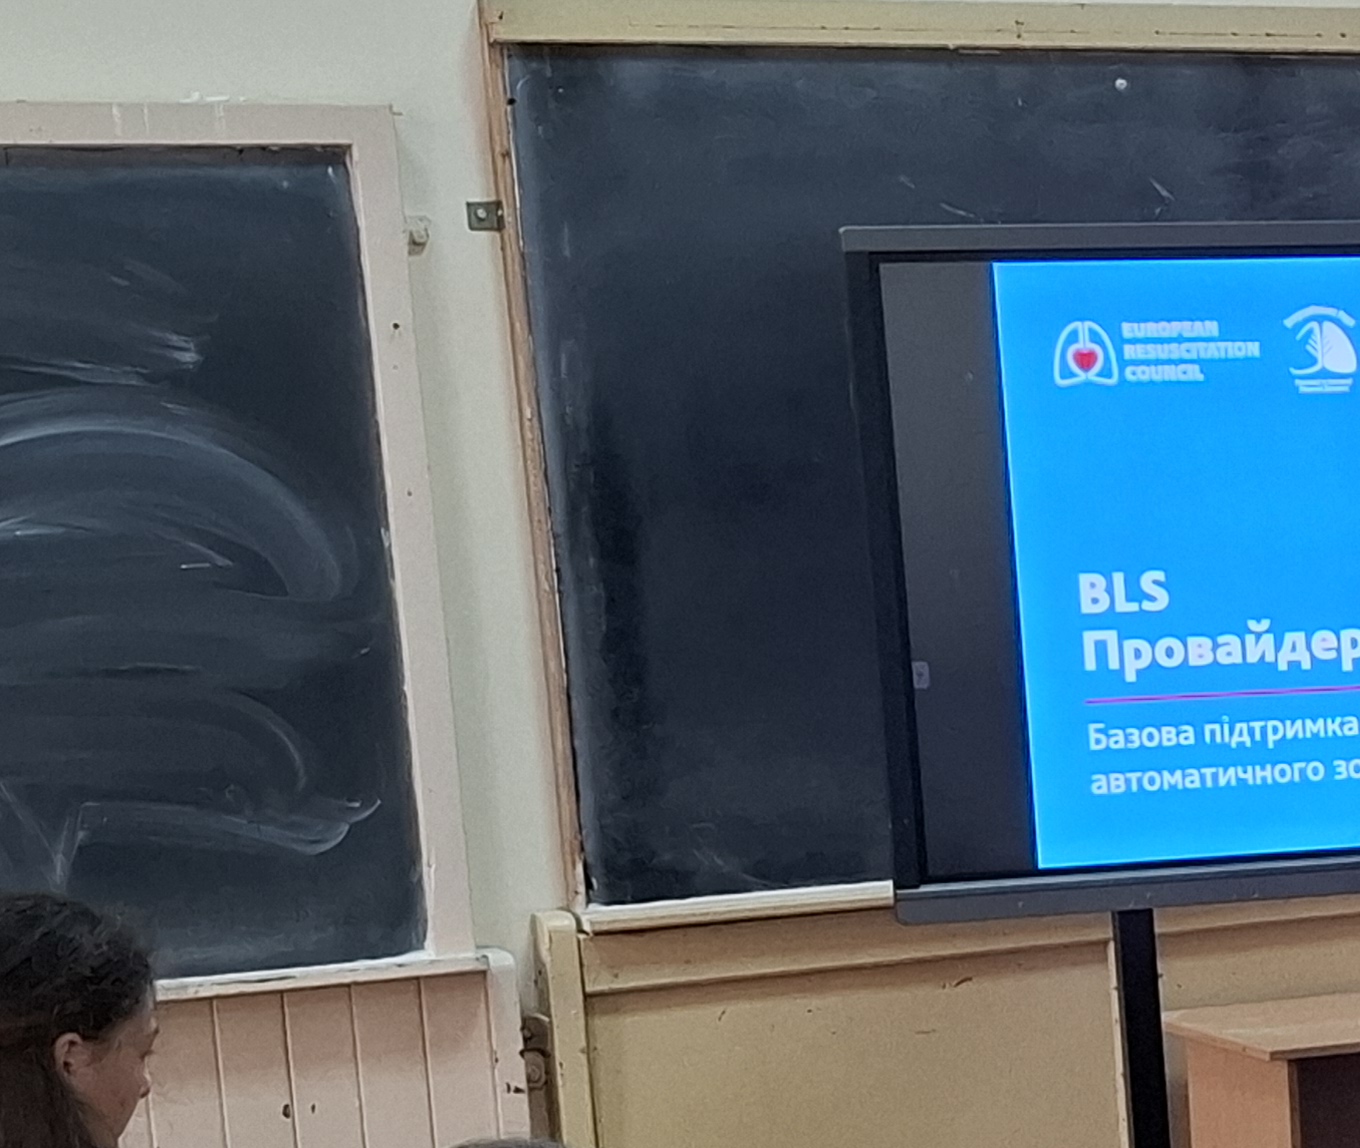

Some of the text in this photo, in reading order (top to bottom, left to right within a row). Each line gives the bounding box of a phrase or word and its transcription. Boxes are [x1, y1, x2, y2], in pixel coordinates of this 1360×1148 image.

[1121, 320, 1219, 339] EUROPEAN
[1123, 342, 1260, 360] RESUSCITATION
[1124, 364, 1204, 382] COUNCIL
[1078, 570, 1170, 614] BLS
[1088, 722, 1195, 750] Базова
[1204, 715, 1359, 749] підтримка
[1091, 759, 1325, 795] автоматичного
